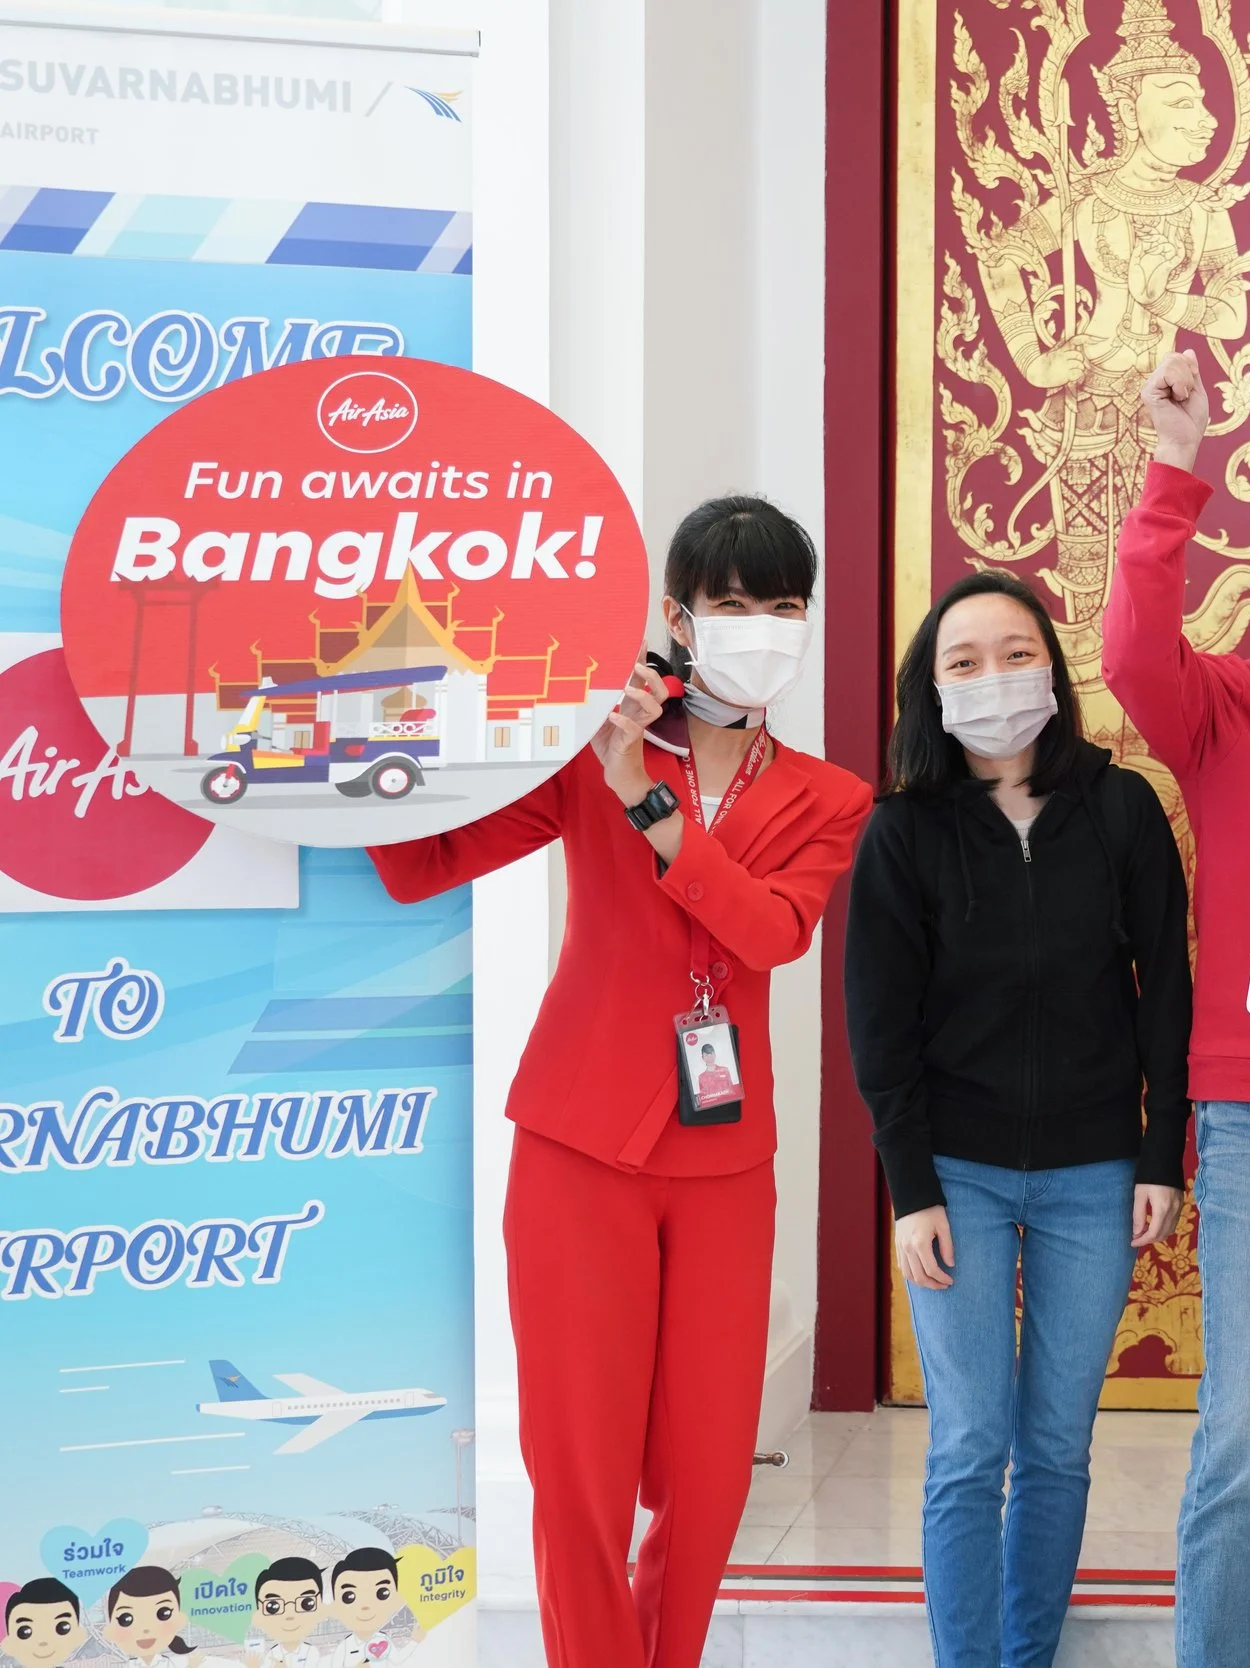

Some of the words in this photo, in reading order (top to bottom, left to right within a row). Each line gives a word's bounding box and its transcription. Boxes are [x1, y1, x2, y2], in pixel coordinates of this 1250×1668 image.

[0, 58, 352, 113] SUVARNABHUMI
[0, 120, 100, 146] AIRPORT
[328, 397, 409, 427] AirAsia
[184, 461, 283, 500] Fun
[301, 461, 489, 500] awaits
[507, 461, 553, 499] in
[110, 511, 604, 599] Bangkok!
[685, 769, 696, 788] ONE
[731, 778, 745, 792] ALL
[690, 788, 700, 807] FOR
[723, 793, 737, 809] FOR
[694, 808, 703, 825] ALL
[44, 957, 165, 1042] TO
[0, 1199, 324, 1301] RPORT
[63, 1537, 125, 1562] ร่วมใจ
[62, 1563, 127, 1580] Teamwork
[420, 1565, 465, 1592] ภูมิใจ
[194, 1577, 248, 1600] เปิดใจ
[419, 1589, 467, 1603] Integrity
[190, 1602, 252, 1617] Innovation
